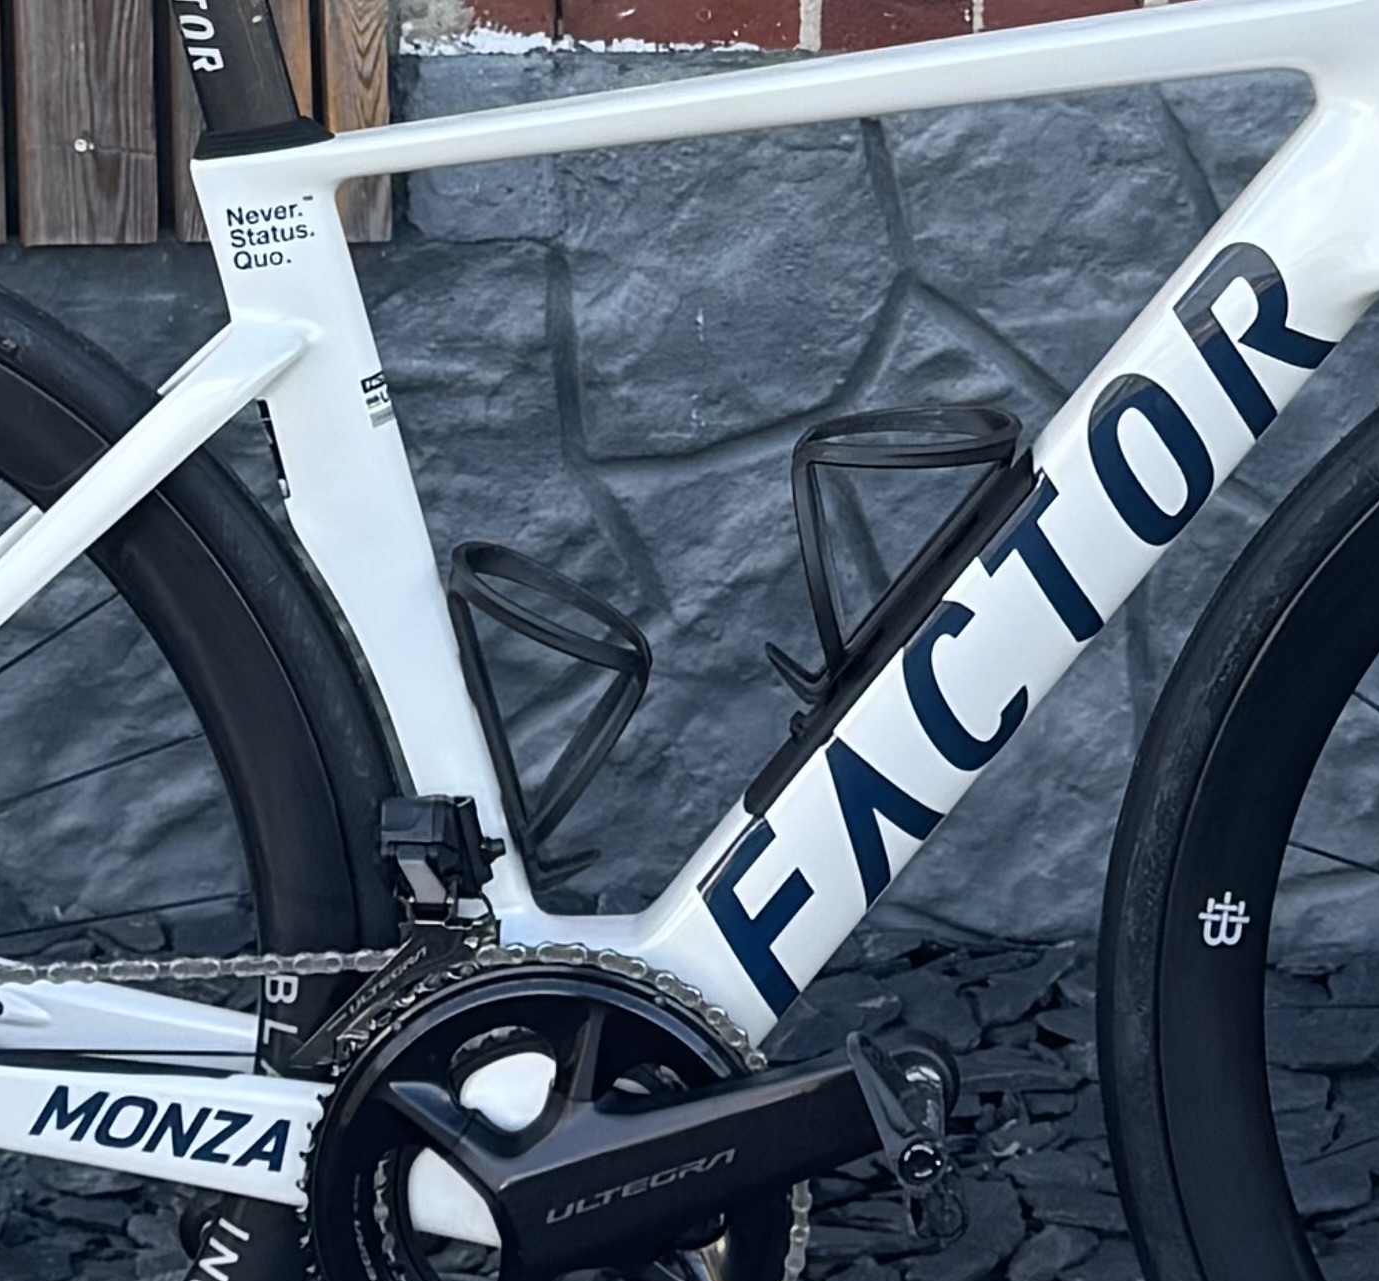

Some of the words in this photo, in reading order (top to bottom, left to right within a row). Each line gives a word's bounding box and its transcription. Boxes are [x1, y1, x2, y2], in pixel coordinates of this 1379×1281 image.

[229, 224, 315, 248] Status.
[233, 250, 292, 271] Quo.
[696, 242, 1342, 1022] FACTOR
[27, 1084, 292, 1173] MONZA
[545, 1147, 737, 1225] ULTEGRA
